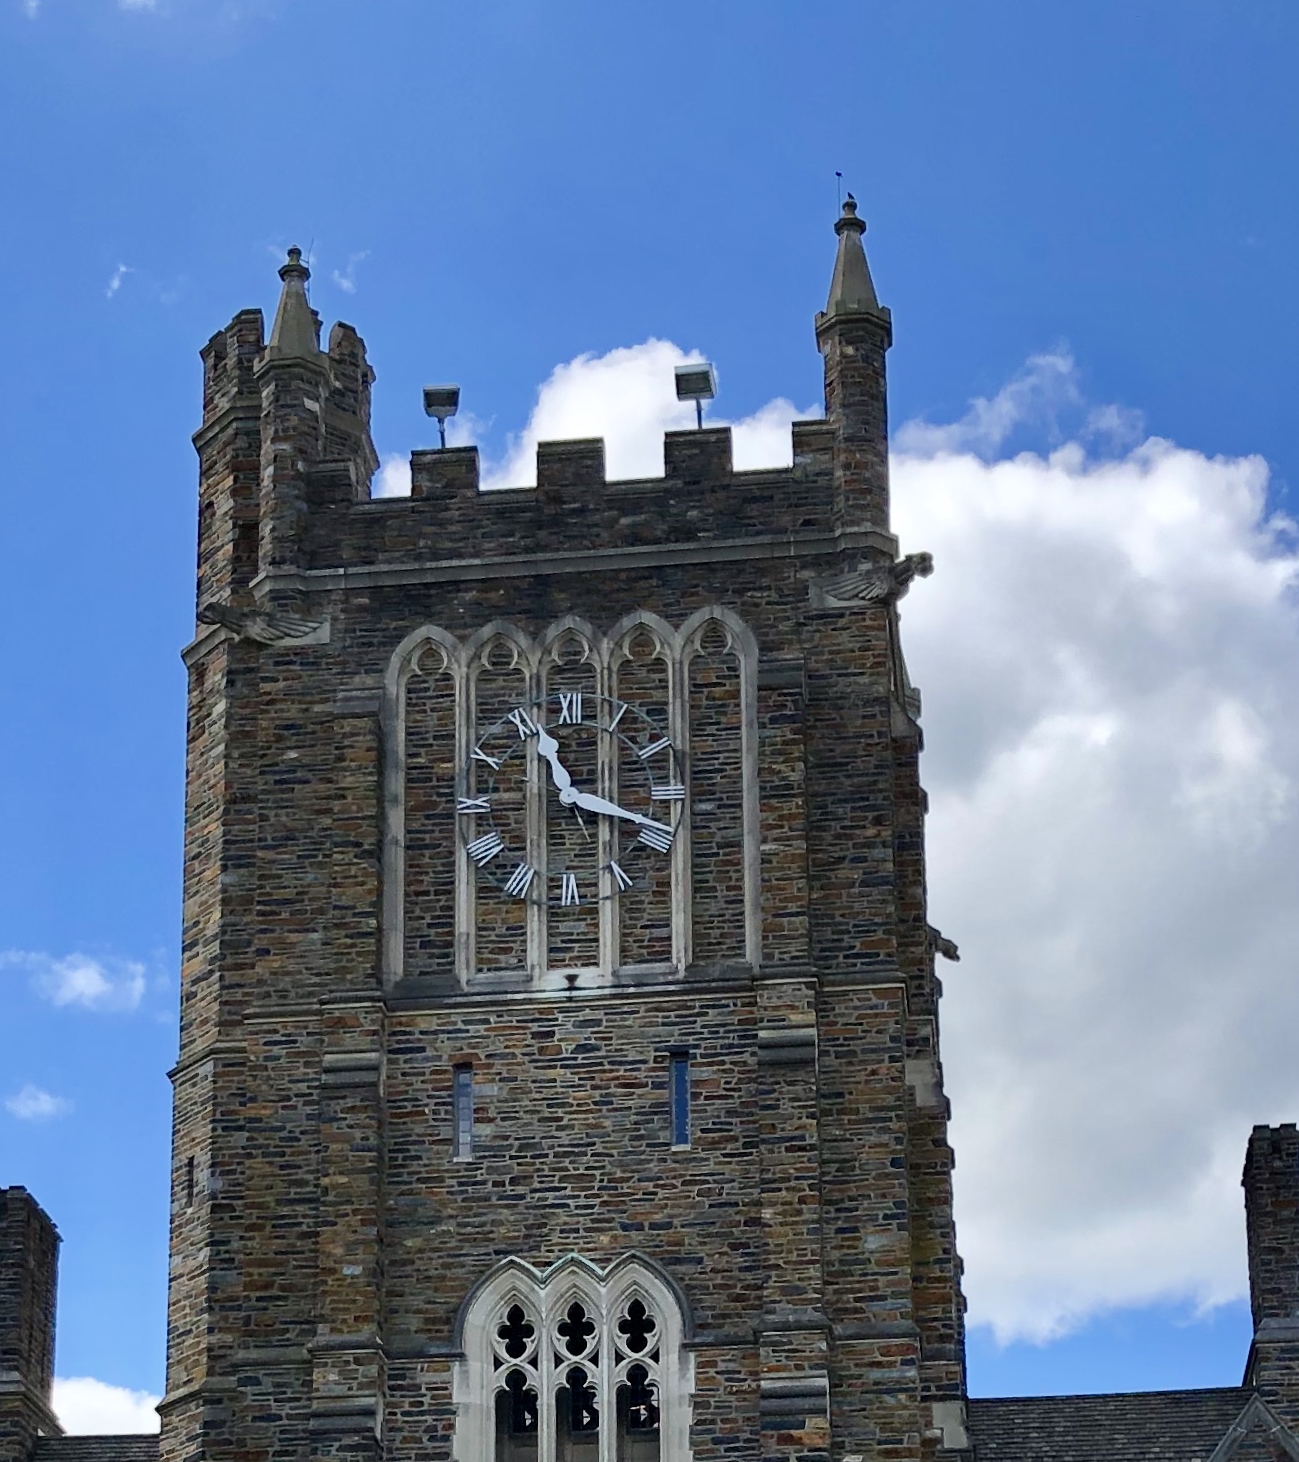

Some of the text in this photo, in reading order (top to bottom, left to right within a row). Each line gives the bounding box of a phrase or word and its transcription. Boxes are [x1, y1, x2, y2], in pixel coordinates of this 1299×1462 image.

[558, 692, 582, 724] XII
[507, 707, 537, 741] XI
[470, 747, 503, 771] X
[638, 736, 671, 760] II
[651, 785, 685, 800] III
